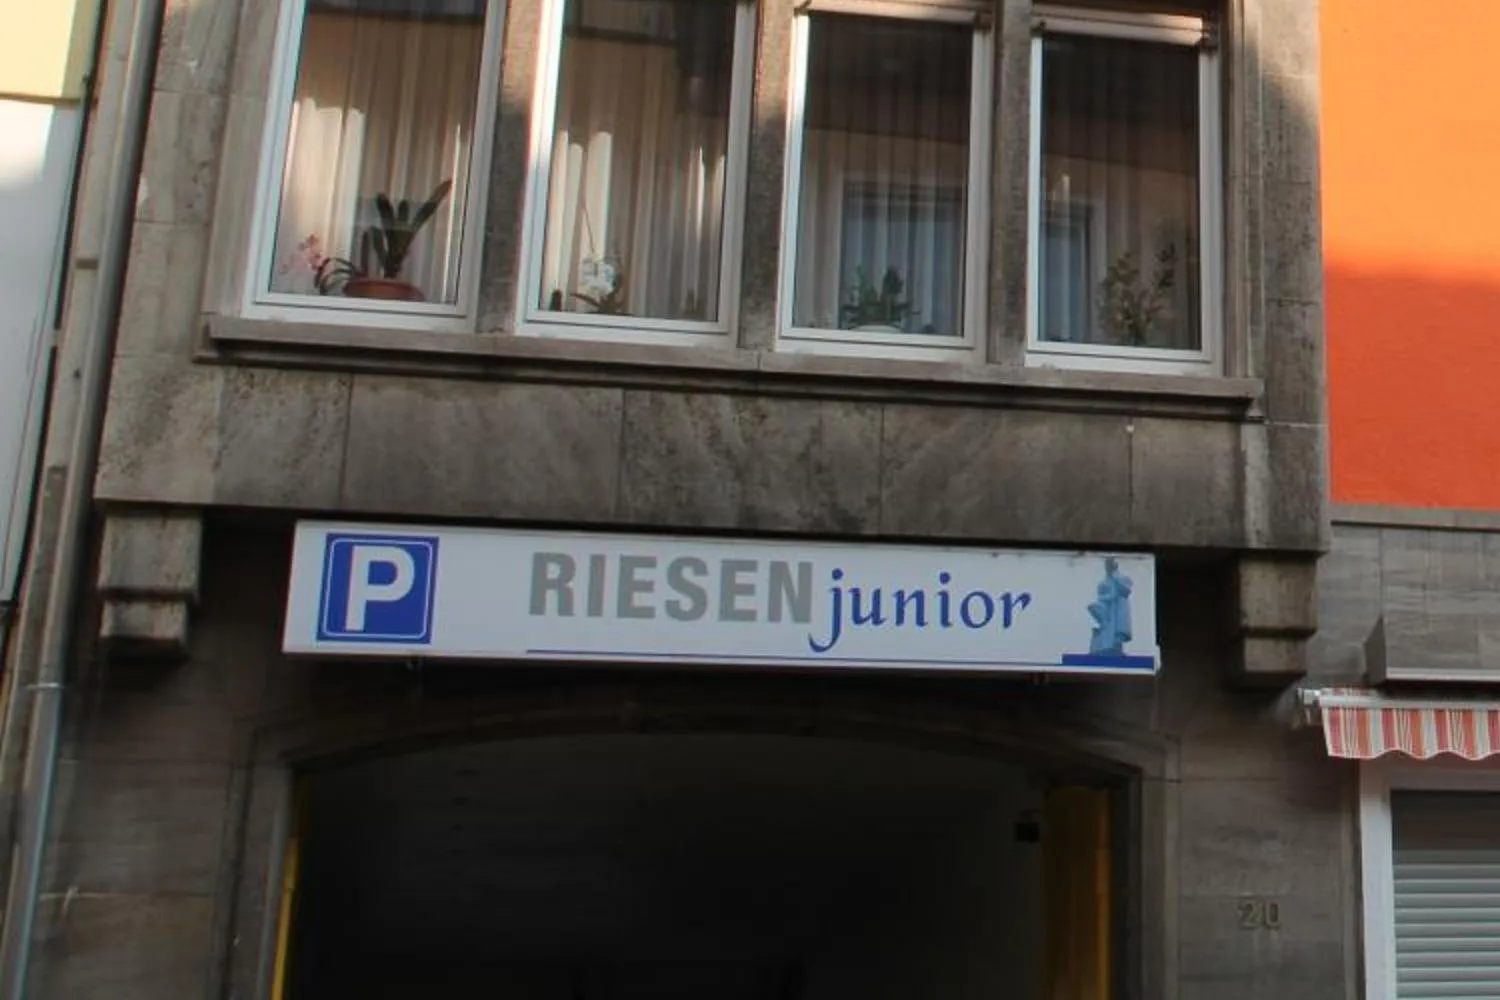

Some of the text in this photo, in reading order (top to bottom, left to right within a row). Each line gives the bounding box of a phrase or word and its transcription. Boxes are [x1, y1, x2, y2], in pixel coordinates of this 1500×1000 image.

[345, 545, 416, 632] P
[528, 551, 1032, 653] RIESEN junior
[1239, 899, 1280, 929] 20
